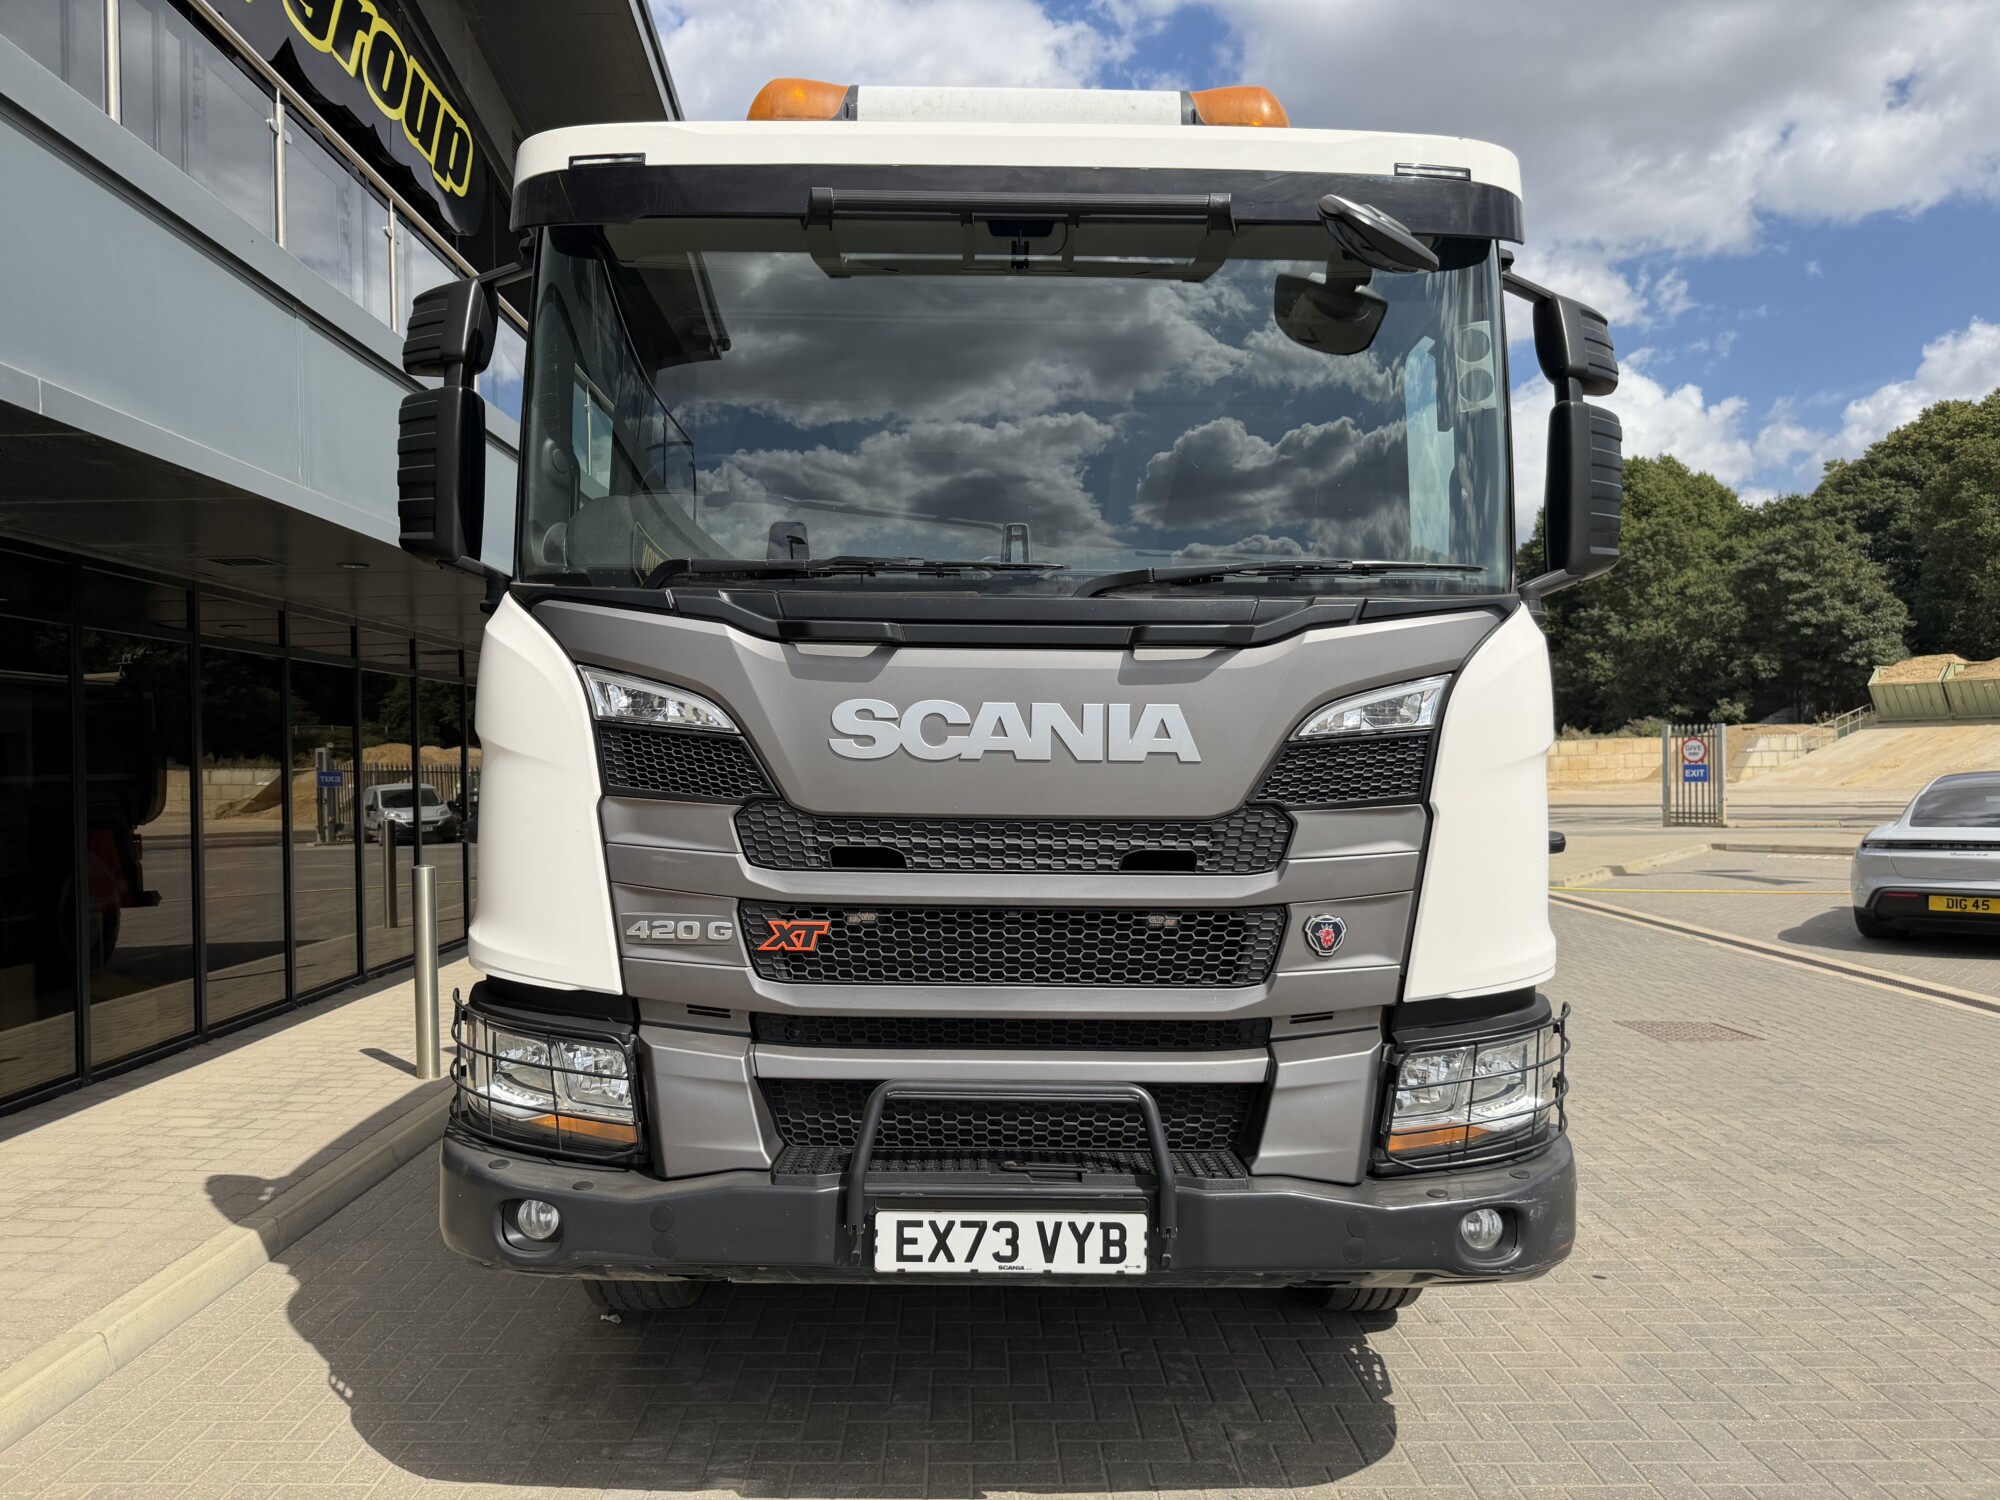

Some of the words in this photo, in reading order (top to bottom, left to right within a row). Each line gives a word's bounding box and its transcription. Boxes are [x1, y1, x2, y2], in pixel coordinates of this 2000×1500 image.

[828, 698, 1201, 762] SCANIA
[1685, 769, 1704, 777] EXIT
[1946, 898, 1968, 909] DIG
[1972, 899, 1990, 911] 45
[626, 920, 700, 940] 420
[707, 921, 733, 940] G
[757, 920, 831, 951] XT
[896, 1219, 1020, 1263] EX73
[1036, 1221, 1127, 1264] VYB
